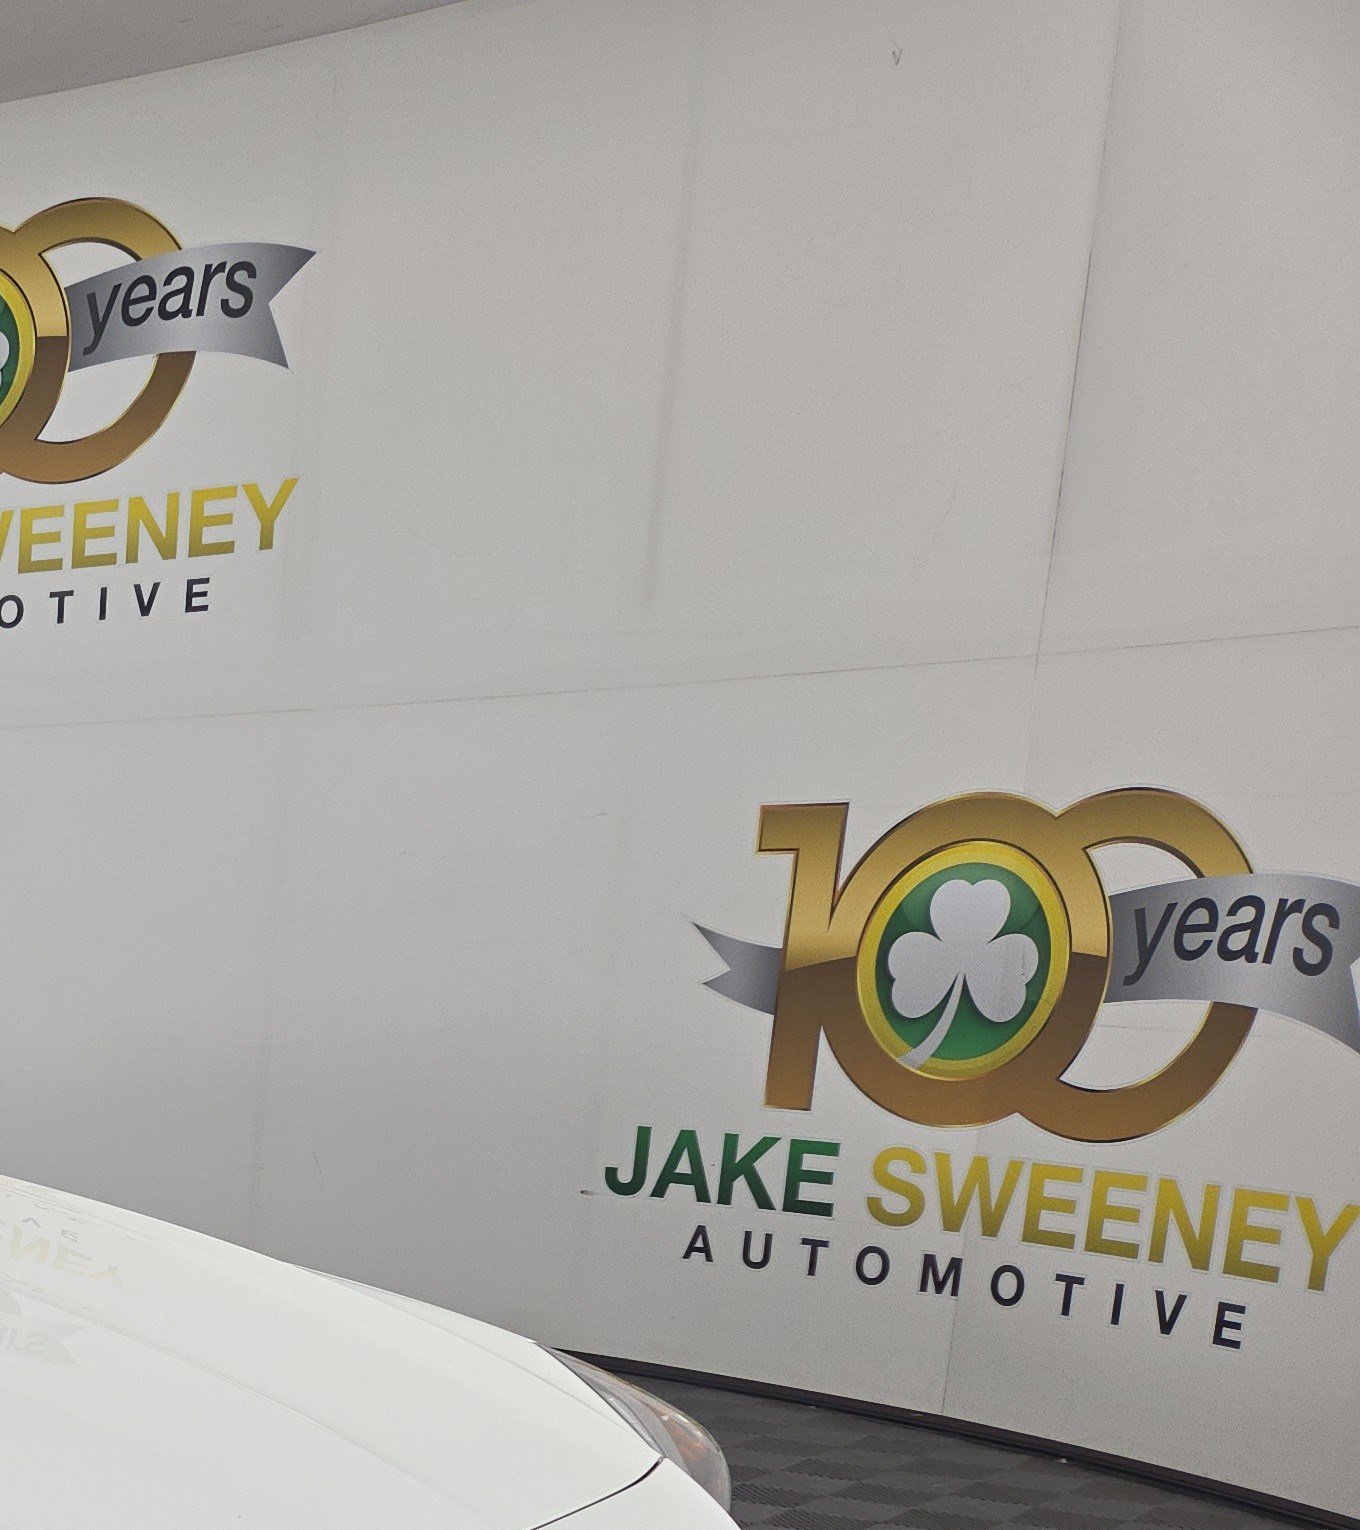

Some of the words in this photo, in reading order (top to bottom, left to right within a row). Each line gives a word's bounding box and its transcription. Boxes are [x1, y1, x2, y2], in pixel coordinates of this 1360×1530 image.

[82, 259, 257, 356] years
[1124, 894, 1340, 987] years
[604, 1125, 841, 1218] JAKE
[865, 1145, 1360, 1292] SWEENEY
[682, 1224, 1246, 1350] AUTOMOTIVE
